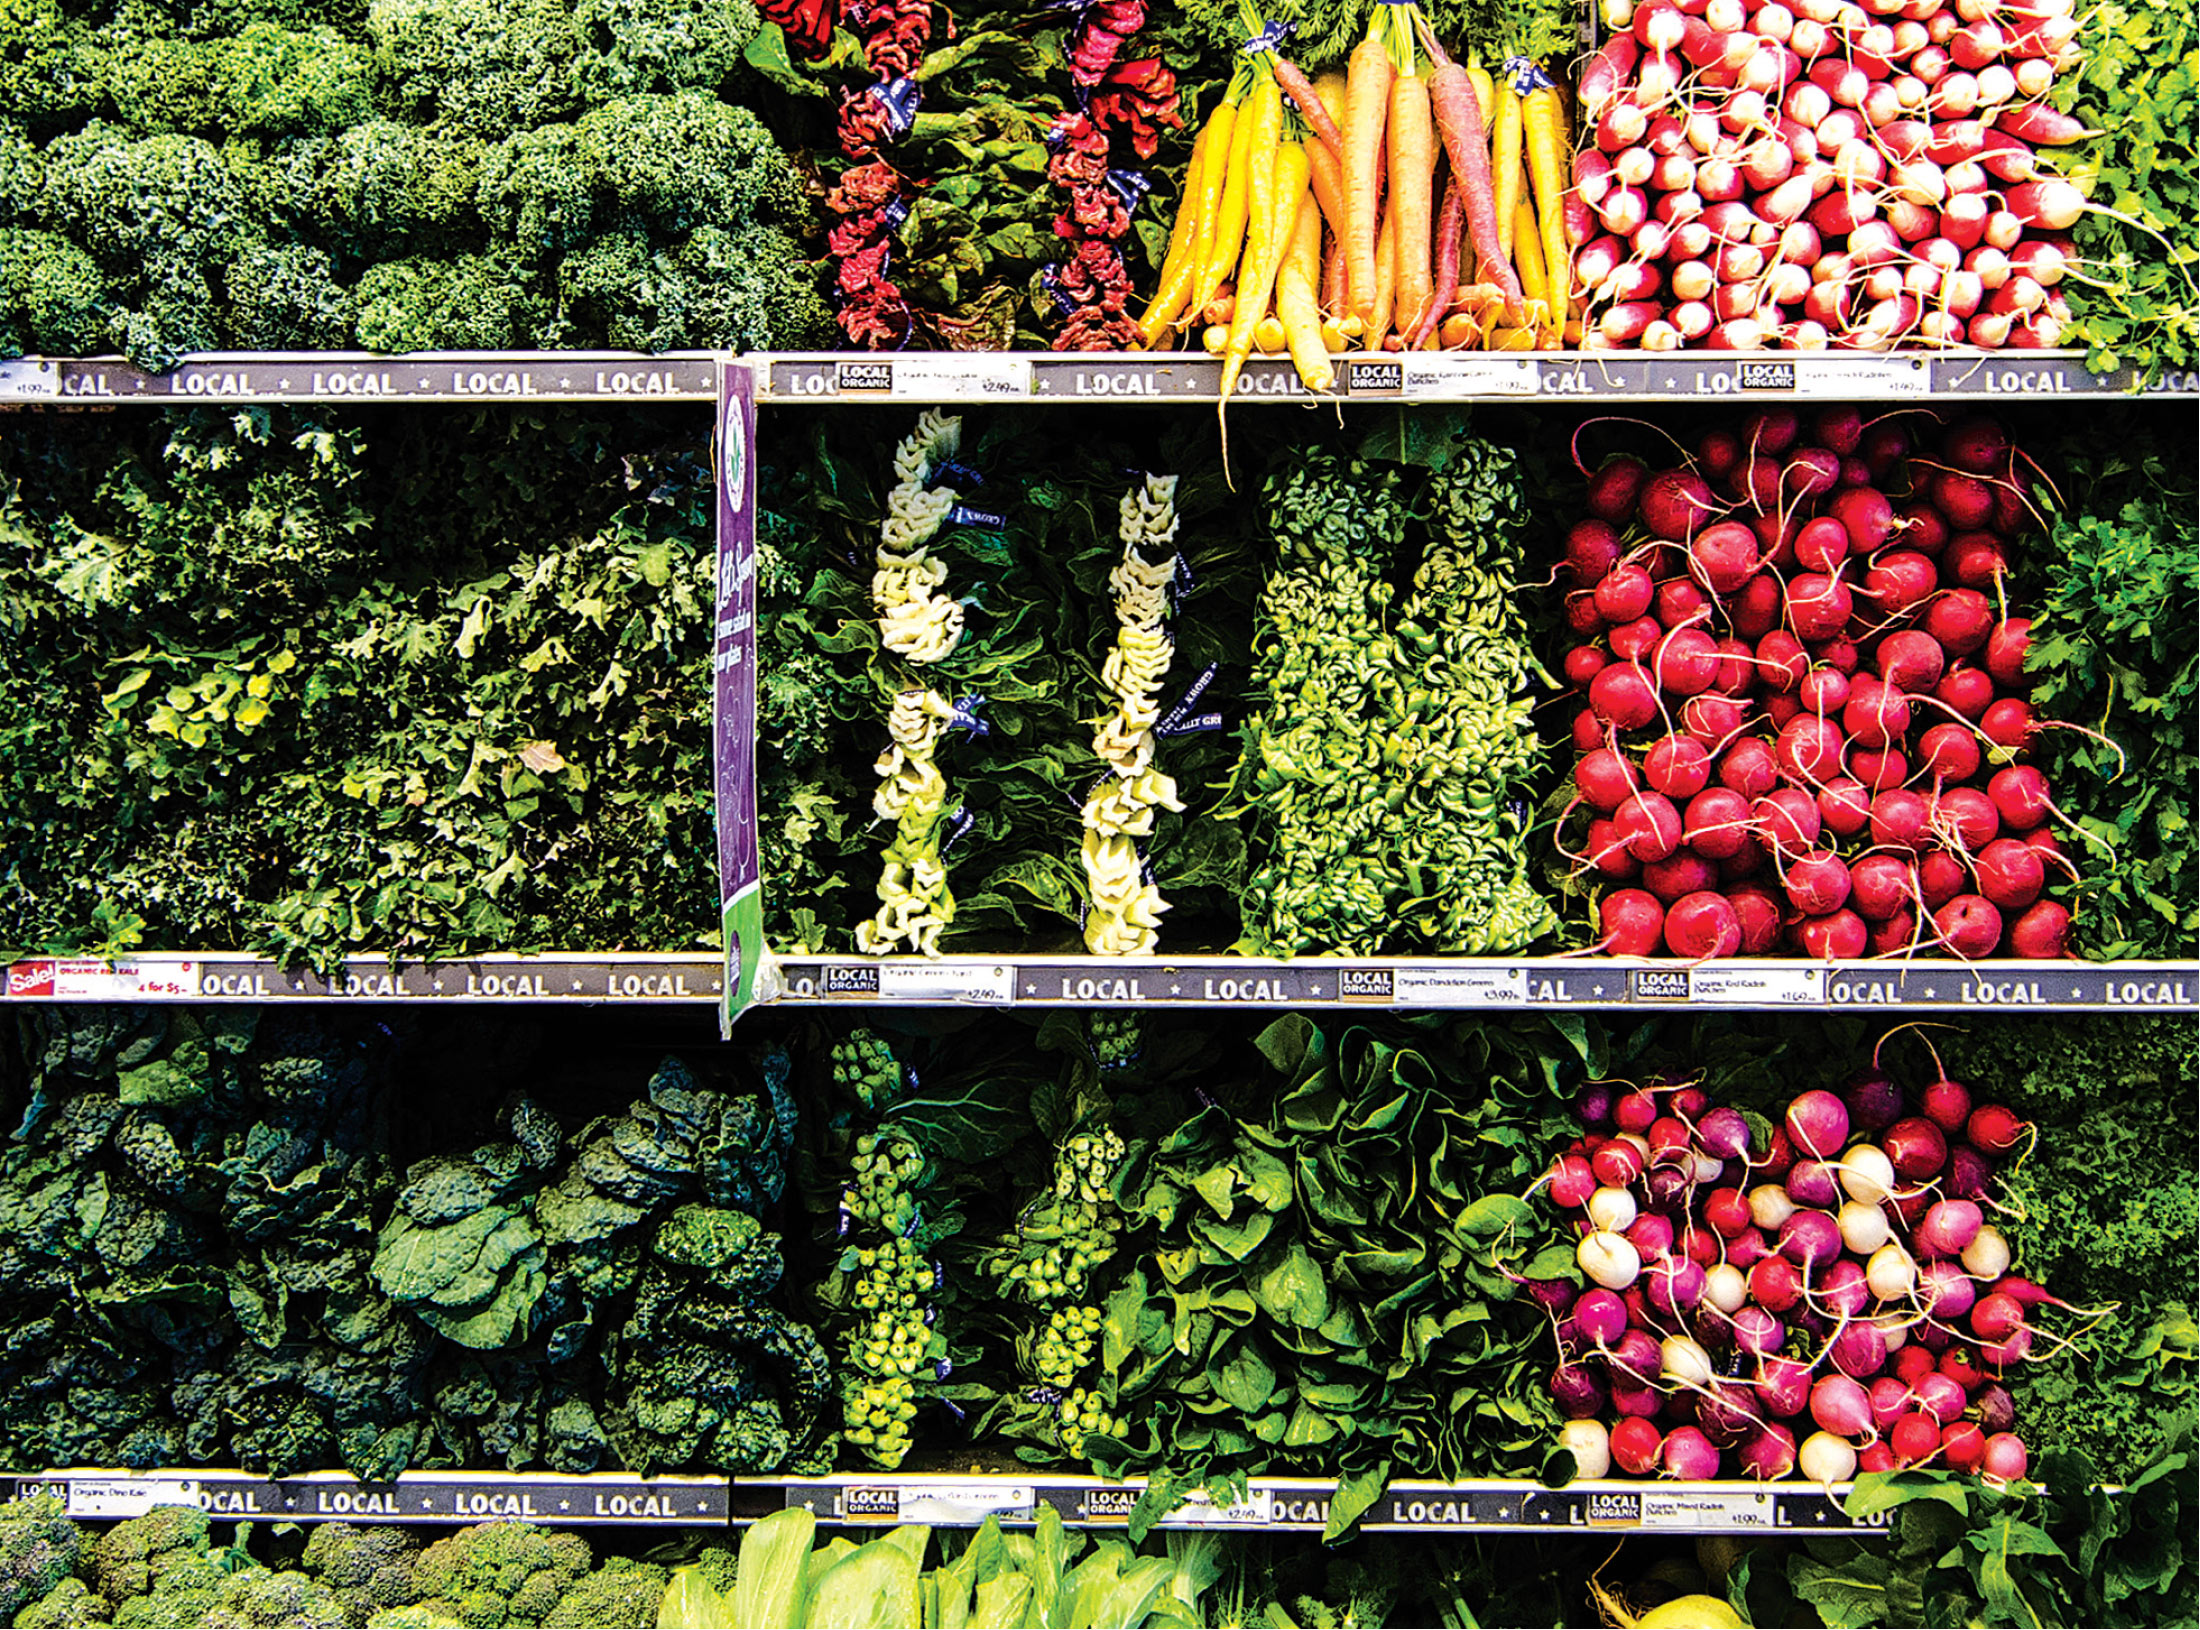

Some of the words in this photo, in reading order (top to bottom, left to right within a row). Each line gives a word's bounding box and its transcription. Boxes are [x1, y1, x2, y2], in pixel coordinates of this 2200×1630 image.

[840, 365, 891, 378] LOCAL
[1351, 366, 1402, 378] LOCAL
[1743, 365, 1795, 378] LOCAL
[63, 373, 113, 394] CAL
[170, 373, 256, 395] LOCAL
[312, 373, 398, 395] LOCAL
[453, 373, 538, 395] LOCAL
[596, 372, 681, 394] LOCAL
[840, 378, 891, 388] ORGANIC
[1075, 373, 1162, 395] LOCAL
[1236, 373, 1306, 394] OCAL
[1351, 378, 1402, 389] ORGANIC
[1542, 371, 1594, 393] CAL
[1743, 378, 1795, 388] ORGANIC
[1985, 371, 2071, 393] LOCAL
[1184, 670, 1215, 704] GROWN
[9, 964, 55, 992] Sale!
[829, 969, 878, 981] LOCAL
[1343, 972, 1391, 984] LOCAL
[1638, 973, 1687, 986] LOCAL
[148, 981, 164, 992] for
[202, 975, 271, 995] OCAL
[467, 975, 550, 996] LOCAL
[608, 975, 692, 996] LOCAL
[829, 980, 878, 990] ORGANIC
[1062, 978, 1146, 999] LOCAL
[1204, 979, 1288, 1000] LOCAL
[1343, 984, 1392, 995] ORGANIC
[1638, 986, 1688, 996] ORGANIC
[1830, 982, 1902, 1003] OCAL
[1961, 982, 2047, 1004] LOCAL
[2105, 982, 2191, 1004] LOCAL
[21, 1484, 67, 1498] LOAL
[74, 1488, 107, 1497] Organic
[109, 1488, 129, 1496] Dino
[129, 1488, 148, 1496] Kale
[849, 1490, 897, 1504] LOCAL
[199, 1490, 261, 1512] OCAL
[318, 1492, 400, 1514] LOCAL
[455, 1493, 537, 1515] LOCAL
[595, 1494, 677, 1517] LOCAL
[1090, 1492, 1137, 1505] LOCAL
[1591, 1494, 1639, 1508] LOCAL
[849, 1504, 897, 1513] ORGANIC
[1090, 1504, 1130, 1514] ORGANI
[1393, 1501, 1477, 1523] LOCAL
[1591, 1508, 1639, 1518] ORGANIC
